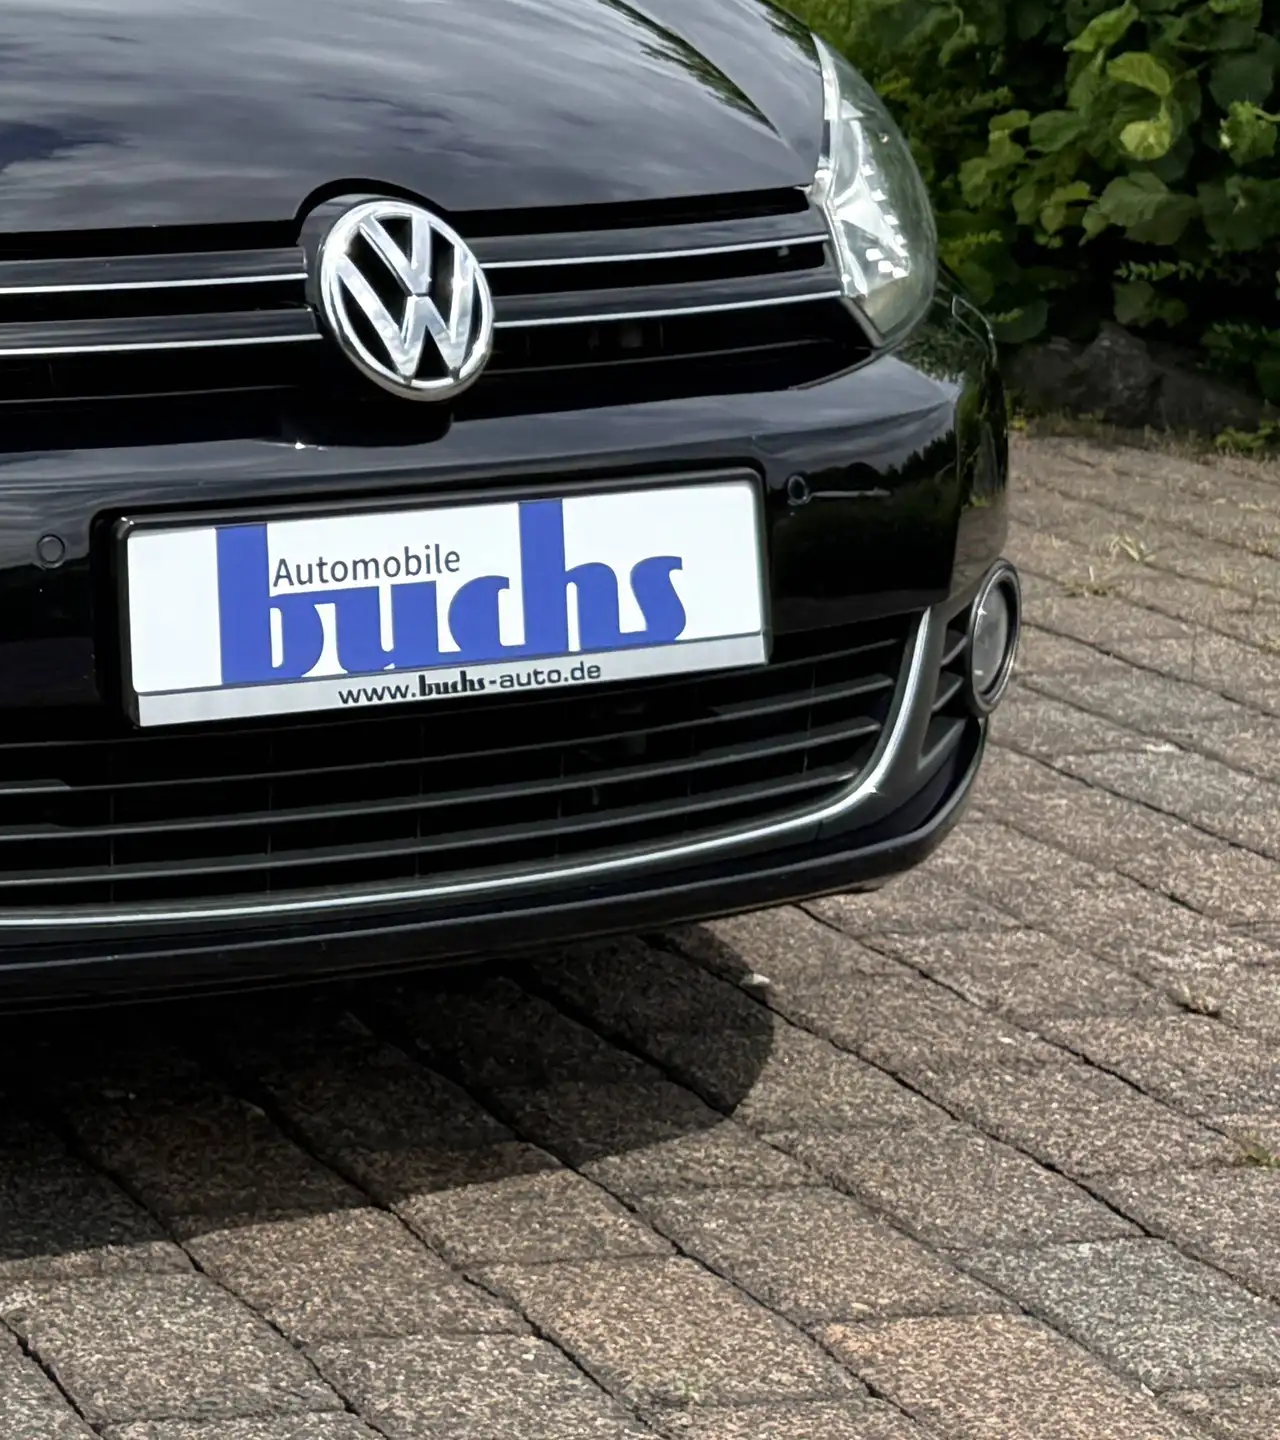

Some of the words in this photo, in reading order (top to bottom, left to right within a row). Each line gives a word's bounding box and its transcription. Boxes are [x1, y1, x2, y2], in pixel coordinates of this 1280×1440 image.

[273, 543, 461, 588] Automobile
[215, 498, 687, 685] buchs
[338, 660, 602, 705] www.buchs-auto.de
